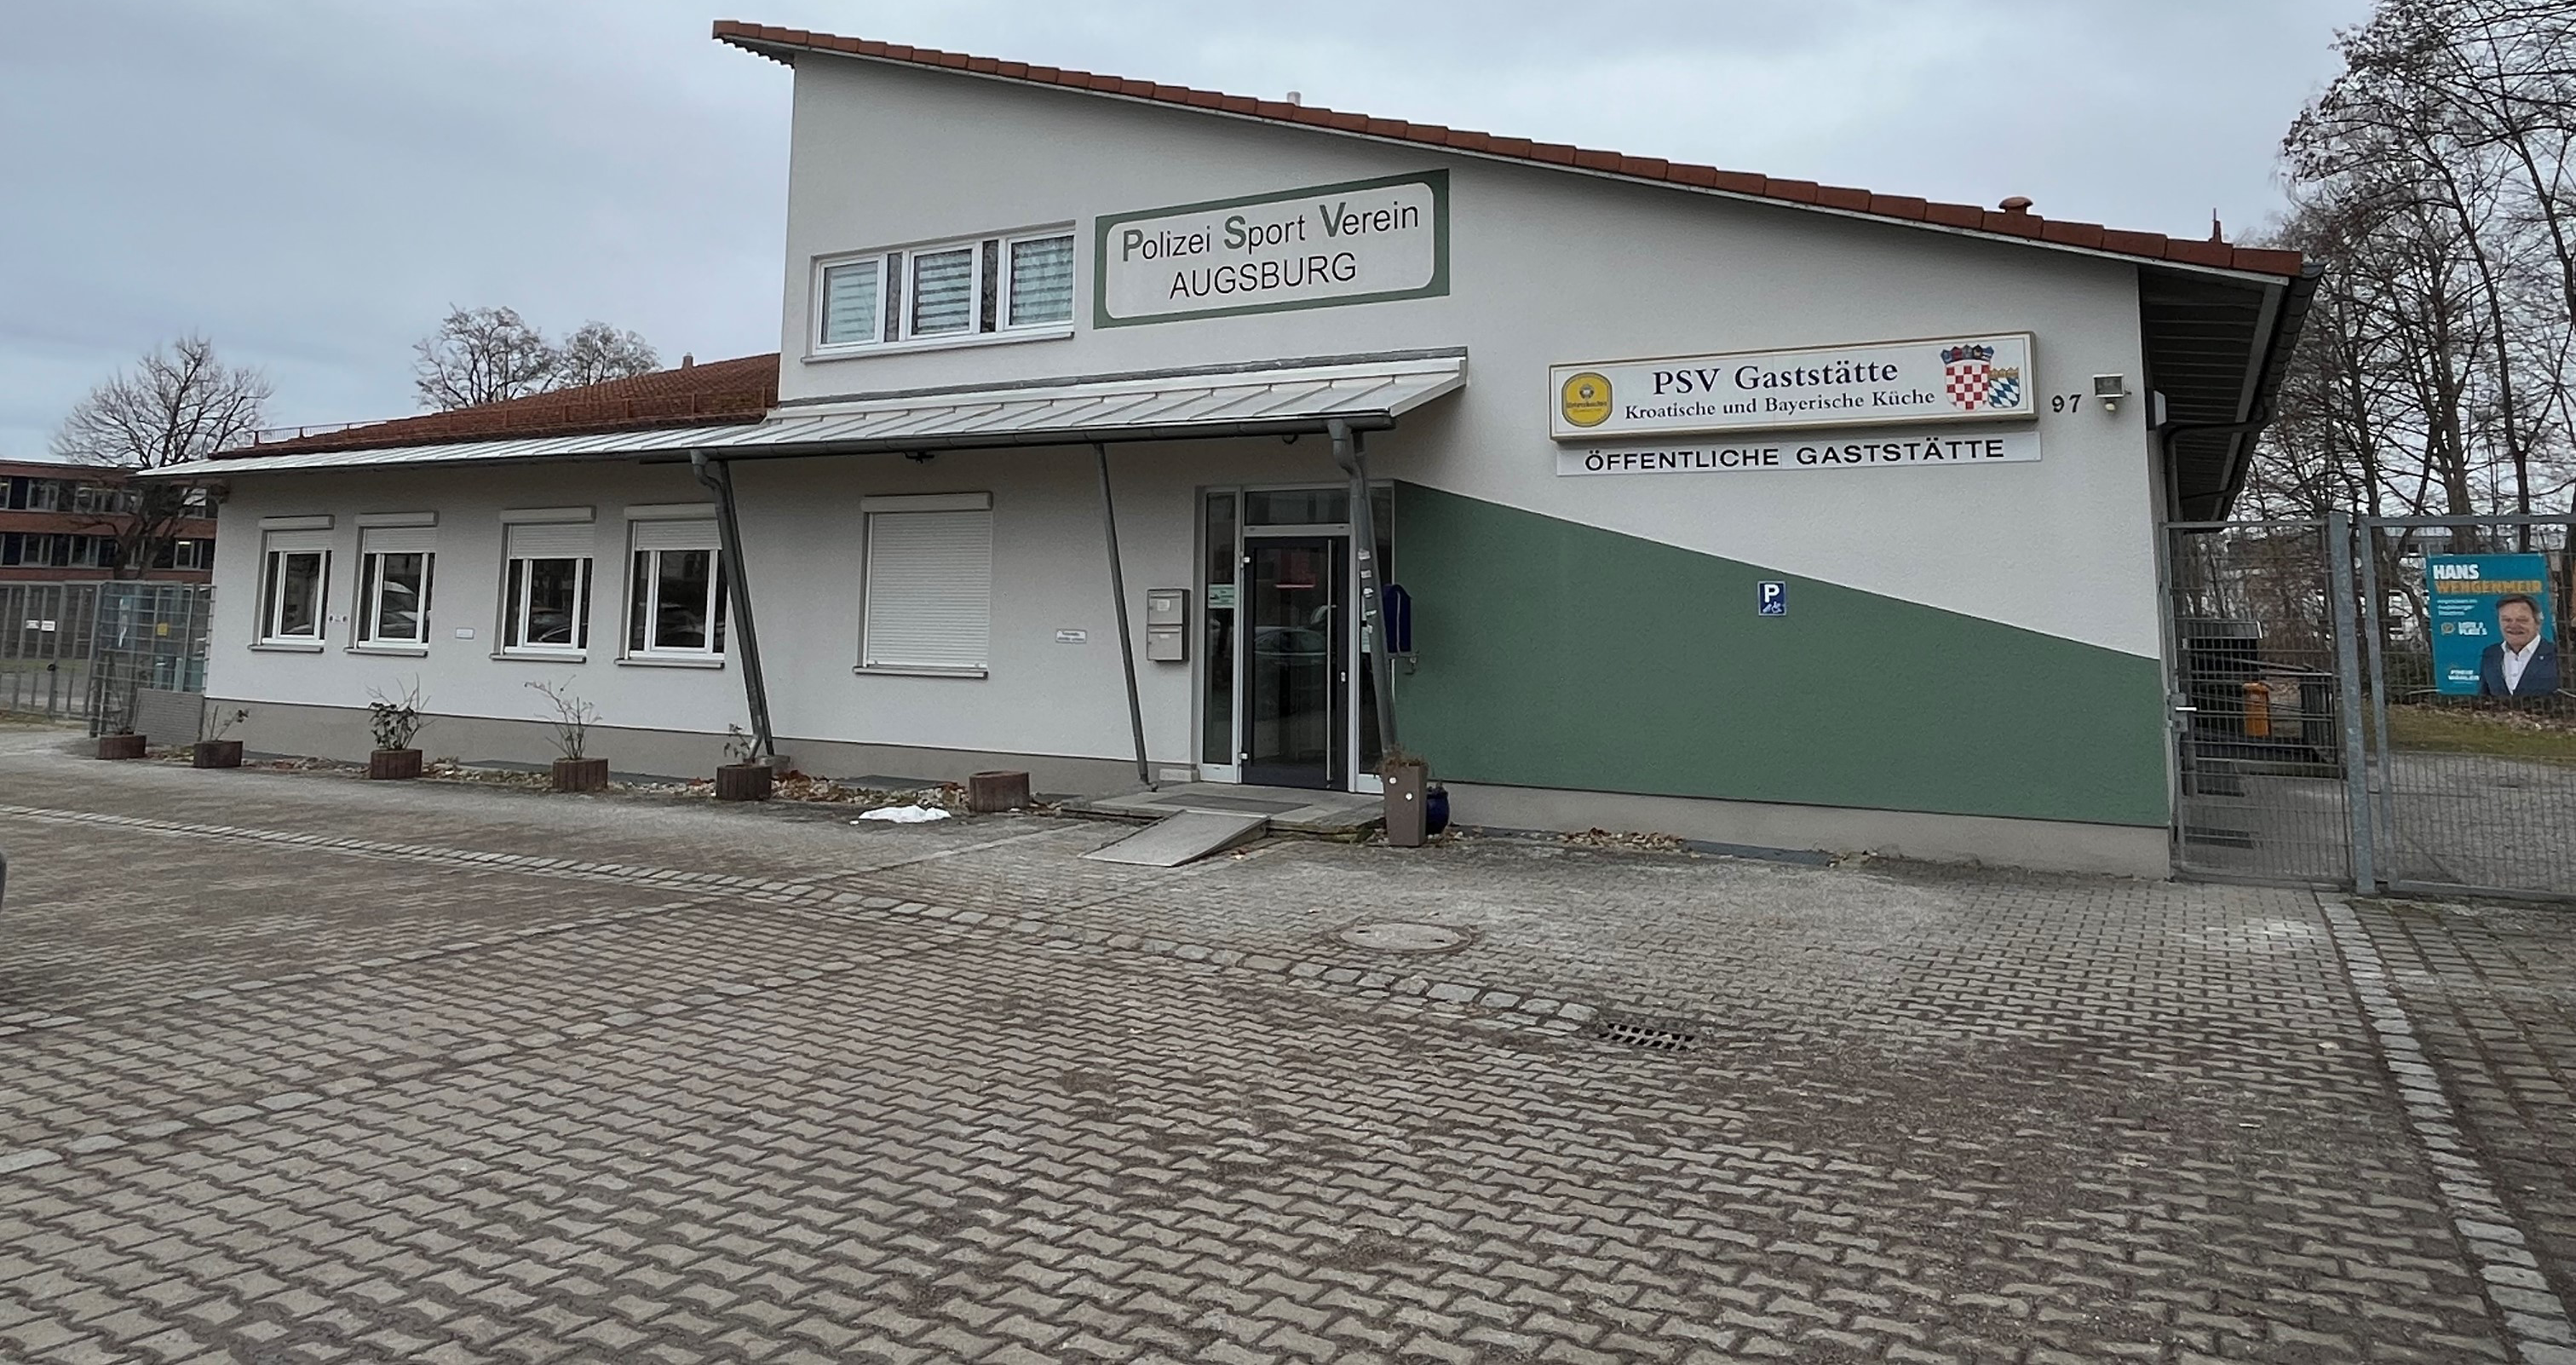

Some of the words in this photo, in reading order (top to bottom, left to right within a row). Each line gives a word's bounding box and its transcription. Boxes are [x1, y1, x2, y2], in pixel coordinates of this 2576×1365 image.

[1122, 226, 1211, 262] Polizei
[1223, 215, 1306, 255] Sport
[1319, 201, 1419, 239] Verein
[1170, 252, 1356, 299] AUGSBURG
[1653, 368, 1721, 395] PSV
[1734, 360, 1899, 390] Gaststätte
[1625, 402, 1716, 419] Kroatische
[1723, 398, 1757, 415] und
[1765, 394, 1864, 415] Bayerische
[1872, 389, 1936, 407] Küche
[2051, 394, 2082, 413] 97
[1584, 449, 1780, 472] ÖFFENTLICHE
[1795, 436, 2004, 466] GASTSTÄTTE
[2433, 564, 2480, 579] HANS
[1764, 584, 1780, 603] P
